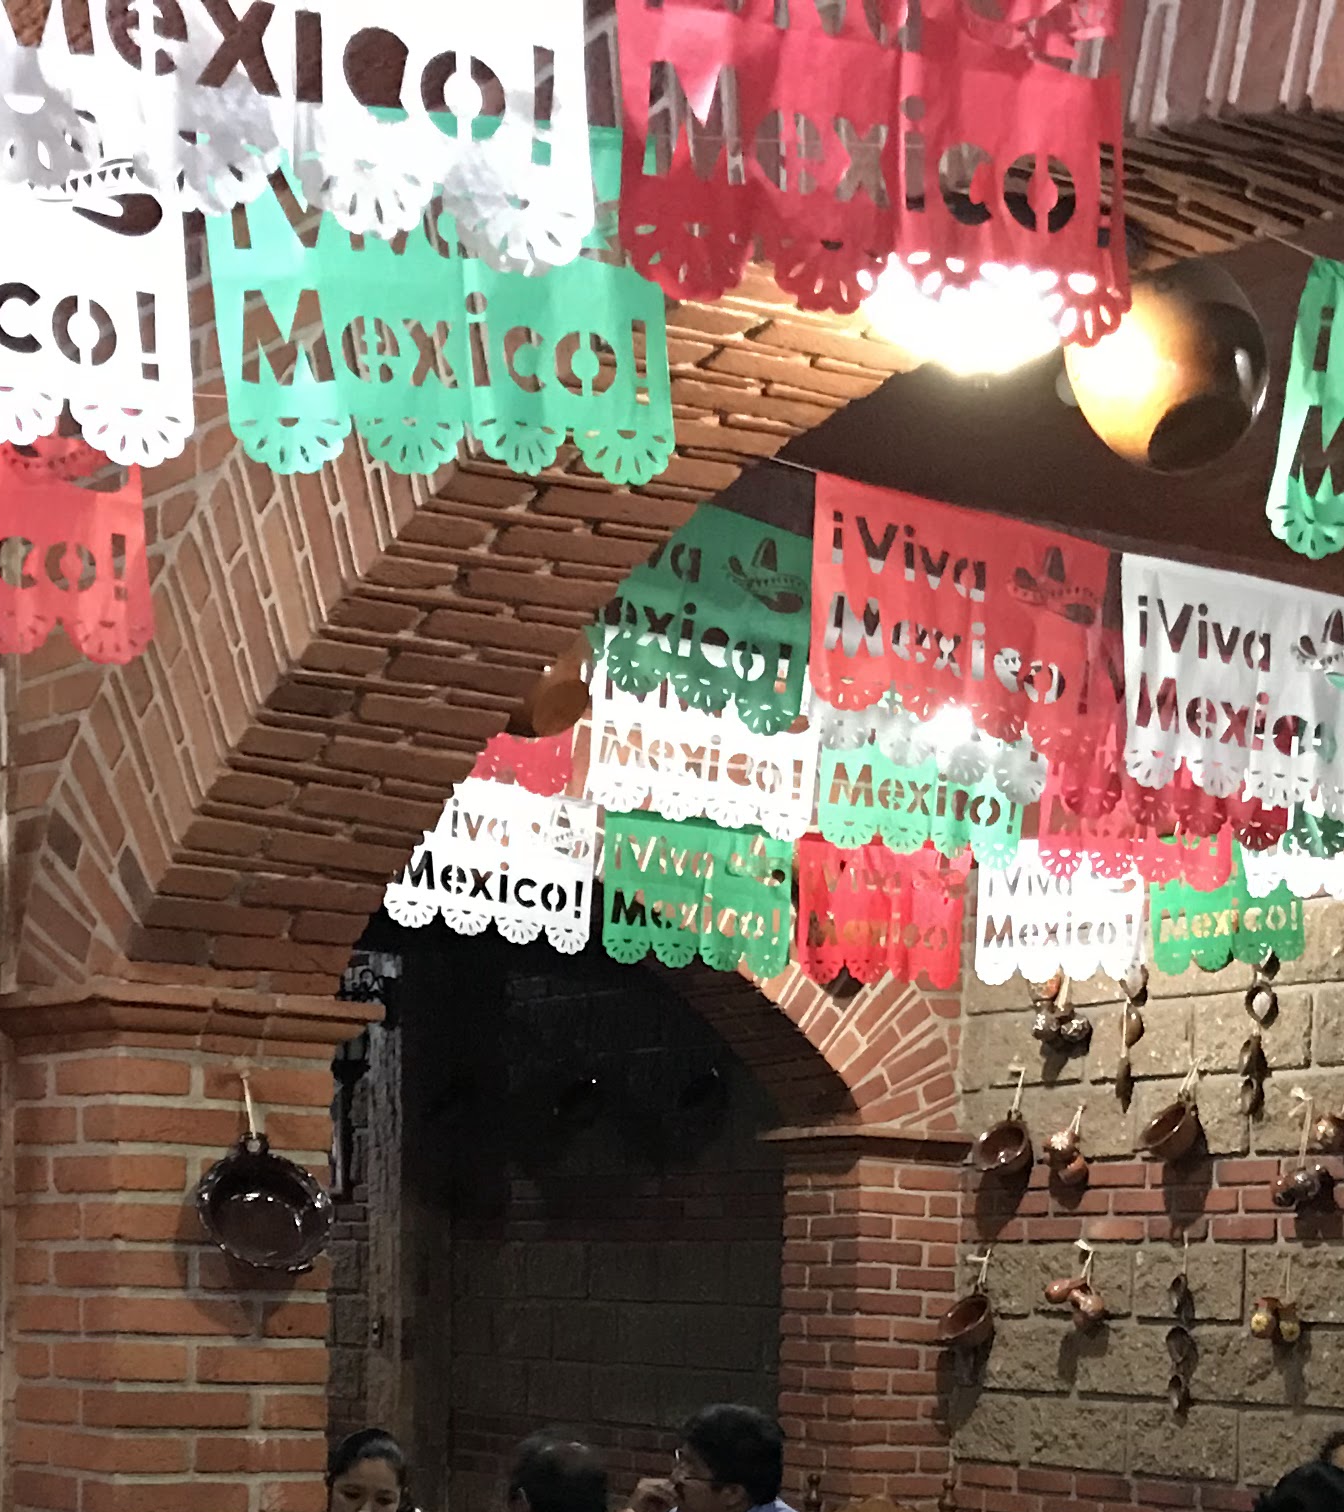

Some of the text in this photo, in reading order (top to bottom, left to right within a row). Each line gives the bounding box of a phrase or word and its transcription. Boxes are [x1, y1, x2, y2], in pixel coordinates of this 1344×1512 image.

[641, 60, 1117, 248] Mexico!
[241, 288, 649, 406] Mexico!
[593, 597, 794, 694] exico!
[824, 591, 1091, 715] Mexico!
[598, 719, 804, 801] Mexico!
[827, 761, 1017, 835] Mexico!
[395, 849, 584, 919] Mexico!
[610, 887, 781, 946] Mexico!
[1158, 898, 1299, 944] Mexico!
[982, 910, 1134, 949] Mexico!
